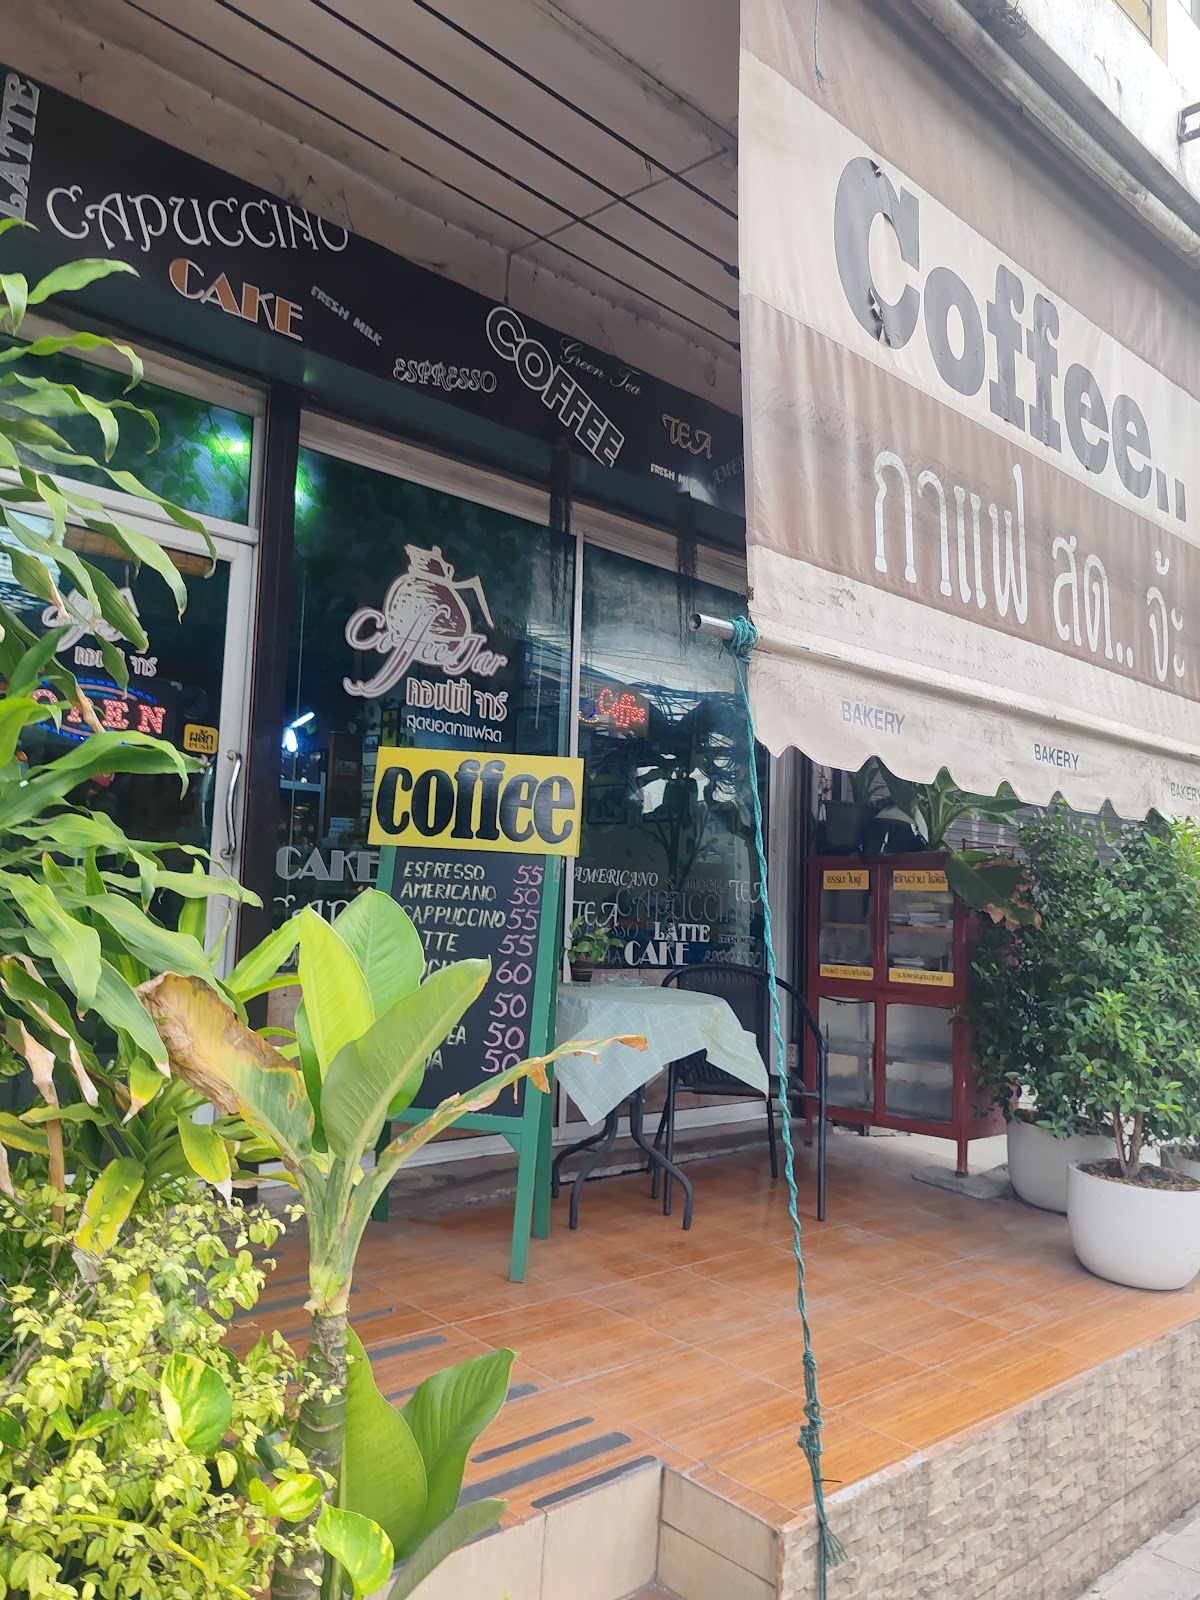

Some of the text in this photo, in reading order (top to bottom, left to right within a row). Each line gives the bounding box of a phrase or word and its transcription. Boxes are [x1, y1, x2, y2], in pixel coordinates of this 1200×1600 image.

[0, 73, 40, 223] LATTE
[46, 185, 348, 251] CAPUCCINO
[169, 258, 303, 341] CAKE
[310, 285, 383, 346] FRESH MILK
[393, 358, 497, 393] ESPRESSO
[560, 338, 640, 395] Green Tea
[486, 306, 625, 468] COFFEE
[662, 414, 712, 459] TEA
[650, 463, 676, 481] FRESH
[874, 451, 1028, 624] กาแฟ
[343, 602, 508, 697] Coffee Jar
[406, 715, 502, 743] สุดยอดกาแฟสด
[841, 700, 906, 735] BAKERY
[189, 729, 214, 746] ผลัก
[189, 741, 214, 751] PUSH
[1034, 743, 1080, 771] BAKERY
[376, 759, 576, 844] coffee
[276, 846, 380, 883] CAKE
[403, 861, 545, 886] ESPRESSO 55
[574, 866, 659, 888] AMERICANO
[400, 881, 541, 906] AMERICANO 50
[506, 908, 541, 931] 55
[572, 900, 619, 928] TEA
[422, 930, 537, 957] TTE 55
[654, 922, 711, 943] LATTE
[624, 940, 690, 966] CAKE
[495, 960, 532, 985] 60
[489, 991, 527, 1018] 50
[483, 1021, 525, 1050] 50
